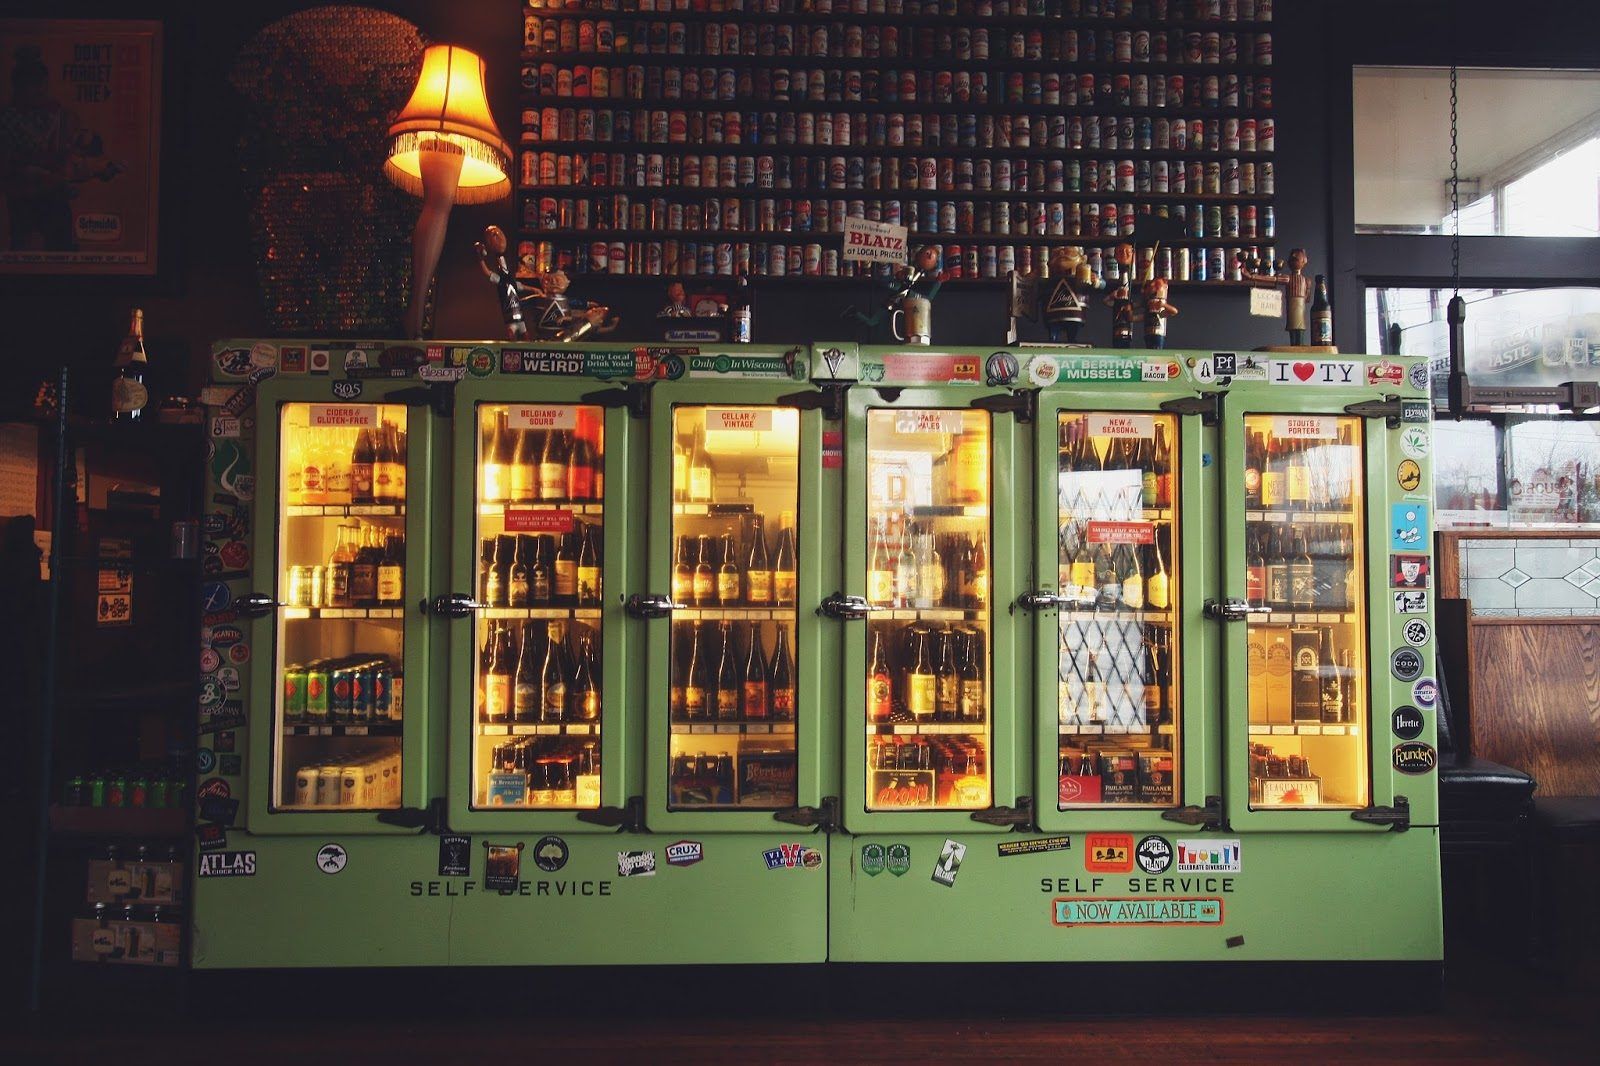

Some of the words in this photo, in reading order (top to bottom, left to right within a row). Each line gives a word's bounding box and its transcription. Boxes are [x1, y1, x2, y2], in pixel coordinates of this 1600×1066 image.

[849, 231, 903, 251] BLATZ
[857, 248, 878, 259] LOCAL
[550, 352, 585, 360] POLAND
[590, 353, 605, 361] Buy
[608, 353, 630, 361] Local
[1489, 344, 1532, 367] TASTE
[524, 360, 585, 373] WEIRD!
[692, 359, 715, 369] Only
[731, 360, 740, 368] In
[740, 359, 788, 368] Wisconsin
[1067, 370, 1131, 379] MUSSELS
[1276, 363, 1289, 382] I
[1320, 364, 1354, 382] TY
[334, 383, 361, 395] 805
[521, 410, 557, 418] BELGIANS
[317, 417, 369, 425] GLUTEN-FREE
[1102, 426, 1138, 434] SEASONAL
[1396, 714, 1419, 730] Heretic
[1395, 748, 1433, 766] Founders
[669, 844, 699, 856] CRUX
[1143, 842, 1166, 851] UPPER
[200, 853, 256, 876] ATLAS
[1146, 860, 1165, 869] HAND
[411, 881, 475, 896] SELF
[498, 881, 612, 896] ERVICE
[1041, 878, 1104, 892] SELF
[1129, 878, 1235, 893] SERVICE
[1076, 903, 1112, 919] NOW
[1117, 903, 1197, 919] AVAILABLE
